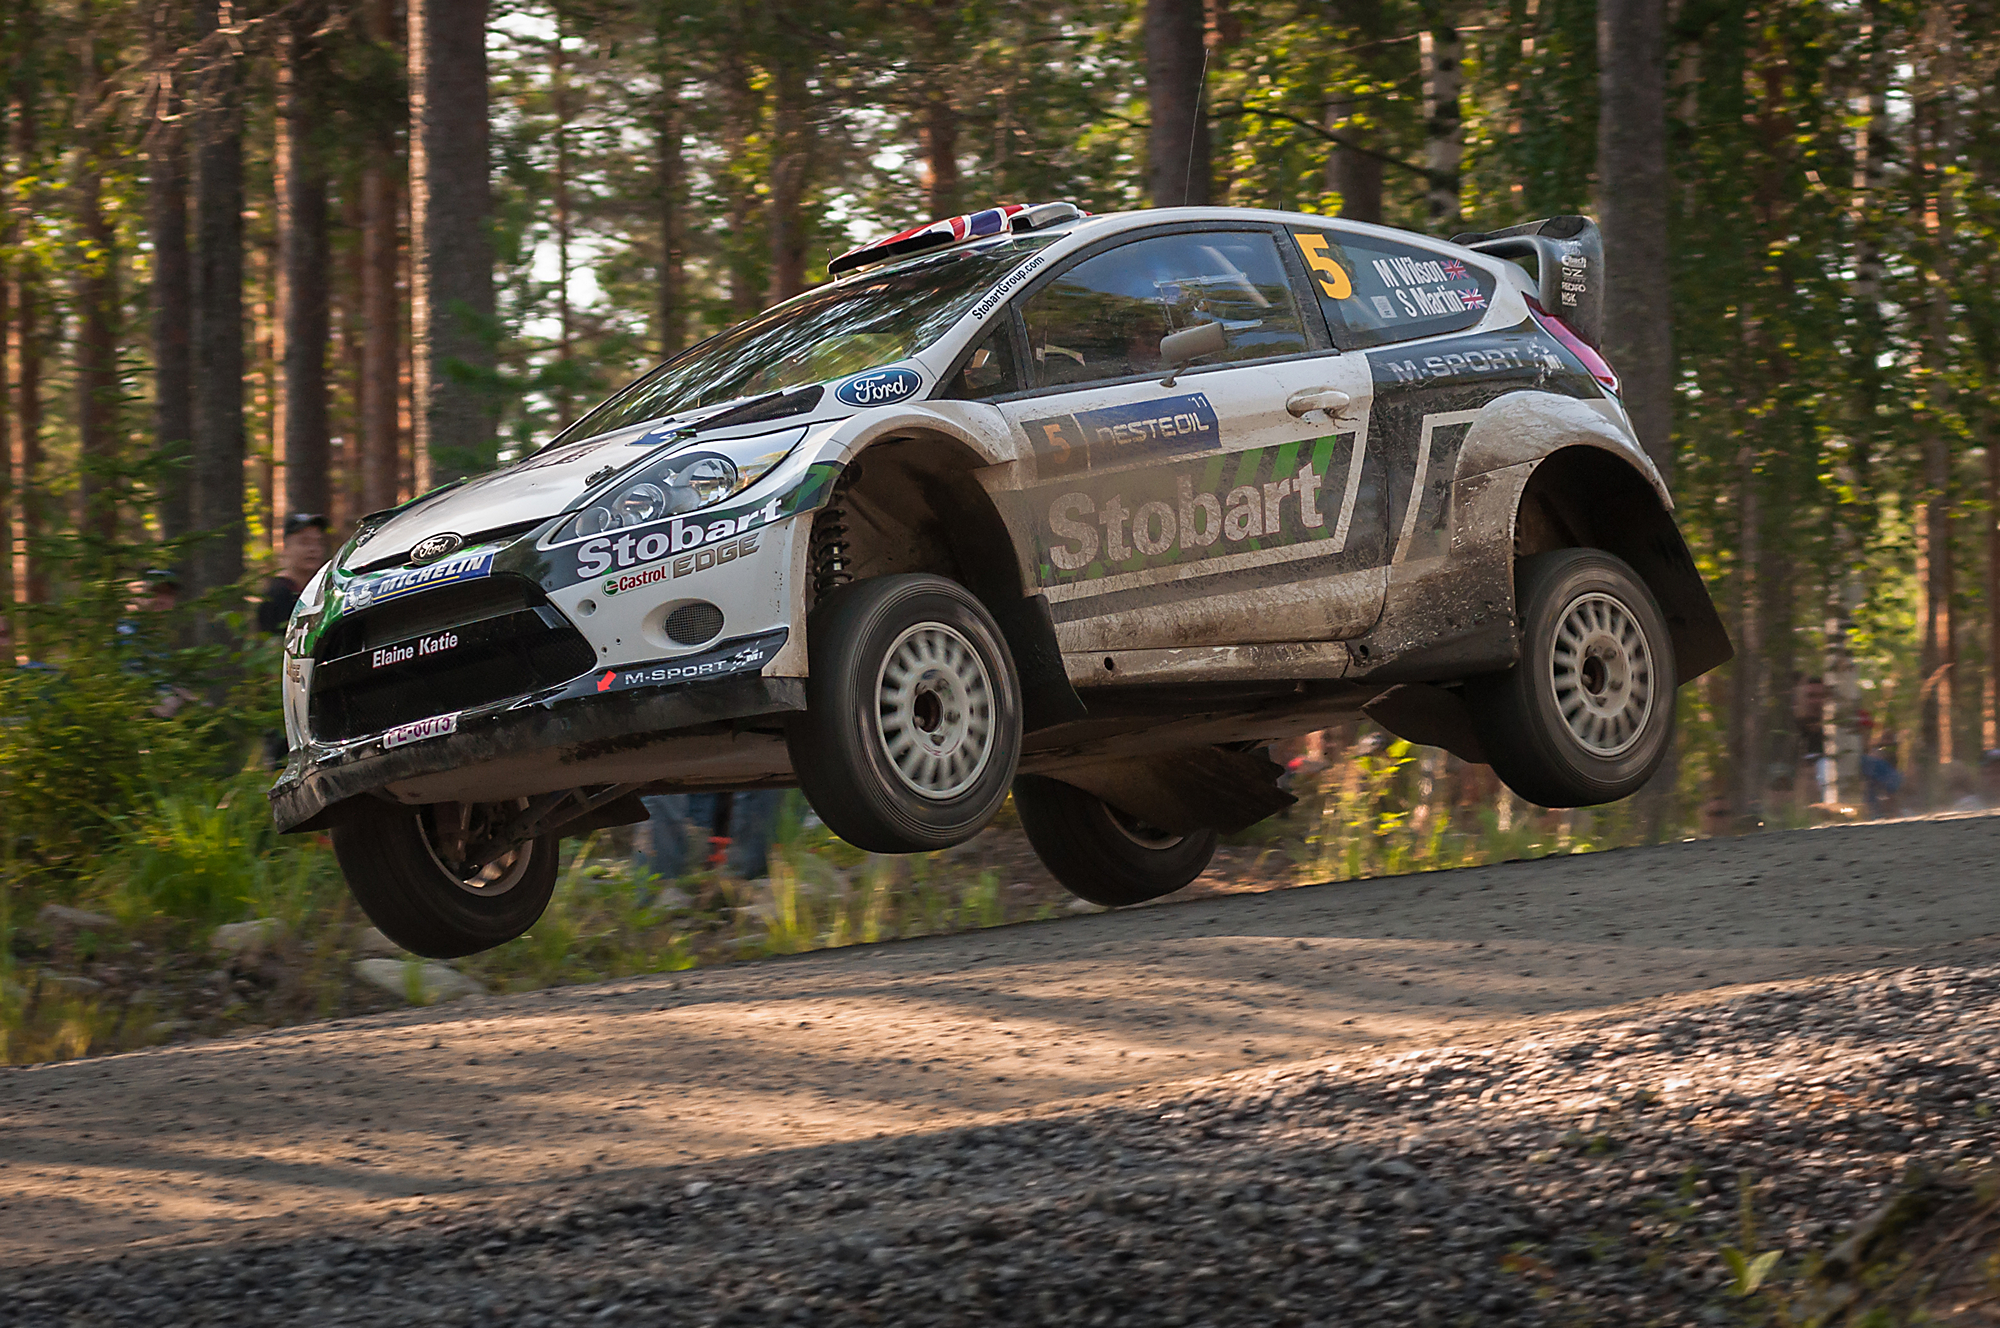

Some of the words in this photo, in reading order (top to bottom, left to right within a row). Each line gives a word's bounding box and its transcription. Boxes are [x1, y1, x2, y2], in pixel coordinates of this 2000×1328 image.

[1294, 233, 1352, 300] 5
[1372, 259, 1391, 289] M
[1389, 256, 1448, 285] Wilson
[971, 255, 1045, 320] StobartGroup.com
[1396, 288, 1418, 318] S
[1413, 284, 1466, 316] Martin
[1043, 424, 1071, 463] 5
[1049, 462, 1323, 570] Stobart
[576, 497, 782, 579] Stobart
[673, 532, 760, 579] EDGE
[377, 554, 487, 595] MICHELIN
[619, 566, 667, 592] Castrol
[372, 644, 414, 669] Elaine
[418, 631, 459, 656] Katie
[625, 660, 728, 685] M-SPORT
